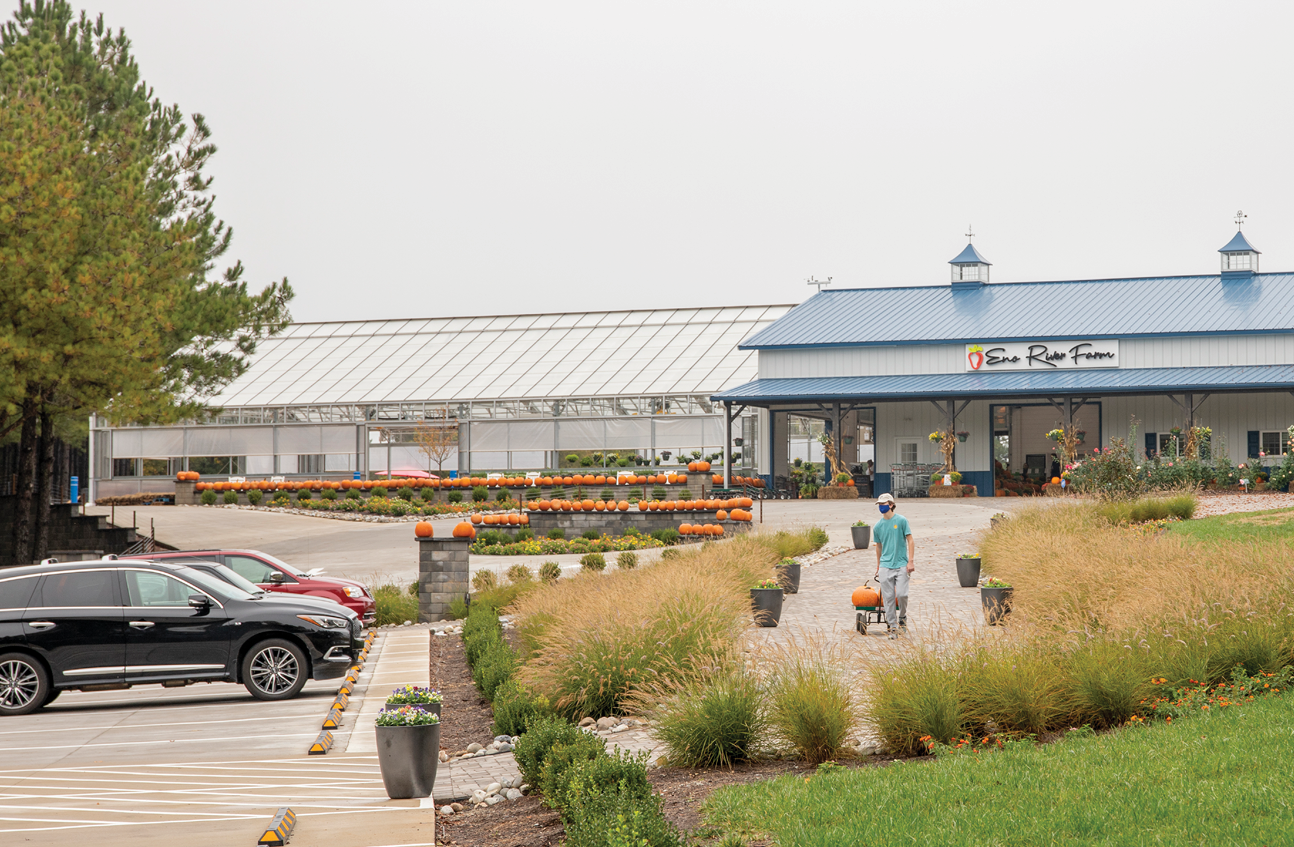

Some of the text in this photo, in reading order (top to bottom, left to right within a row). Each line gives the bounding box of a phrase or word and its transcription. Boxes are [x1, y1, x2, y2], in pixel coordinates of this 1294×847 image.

[985, 343, 1115, 367] Eno River Farm
